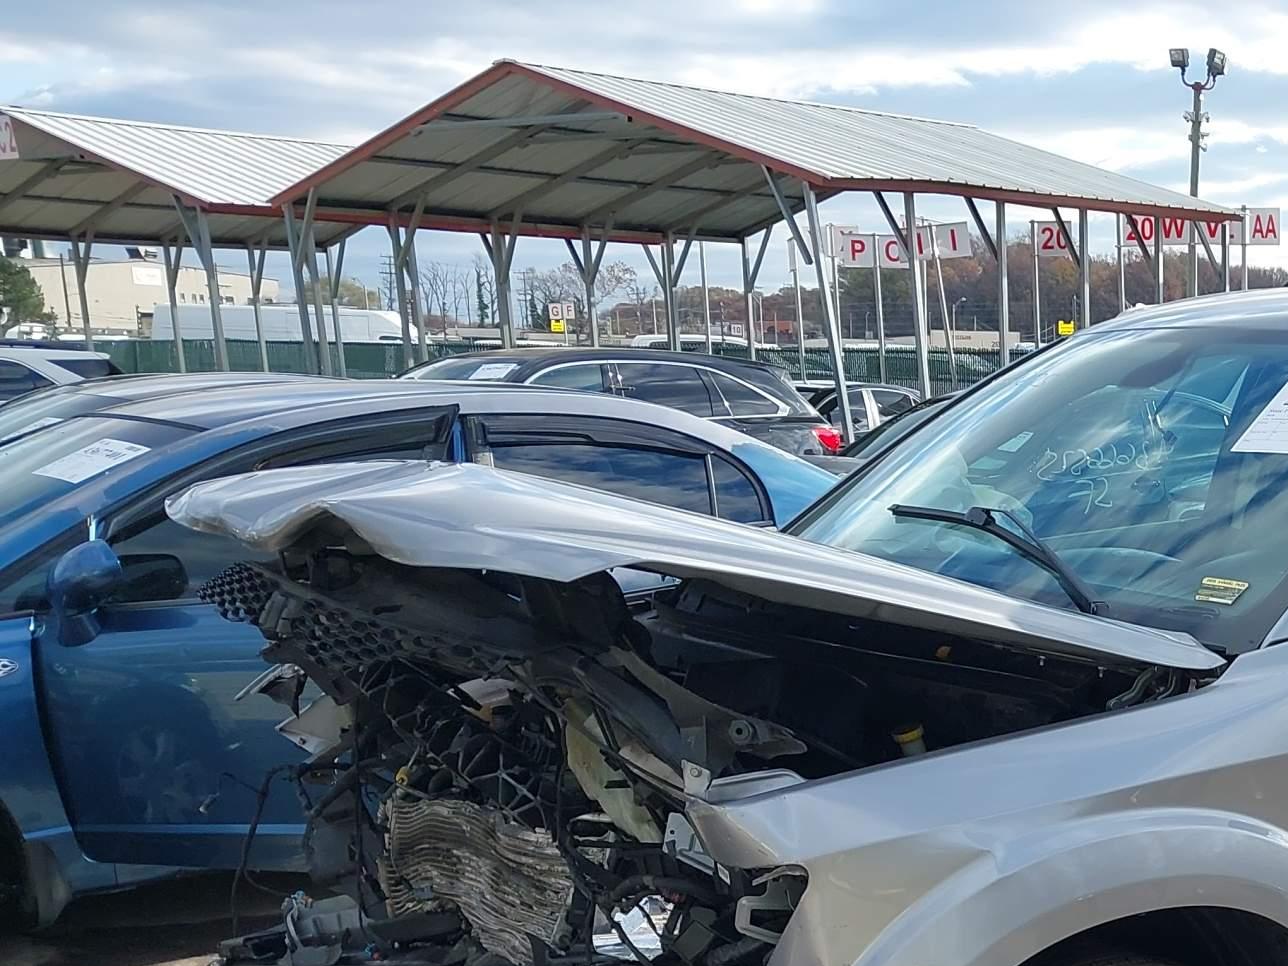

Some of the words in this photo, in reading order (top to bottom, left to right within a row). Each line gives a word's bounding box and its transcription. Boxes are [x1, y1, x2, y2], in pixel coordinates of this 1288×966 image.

[1161, 217, 1184, 238] W
[1252, 214, 1277, 238] AA
[850, 239, 865, 261] P
